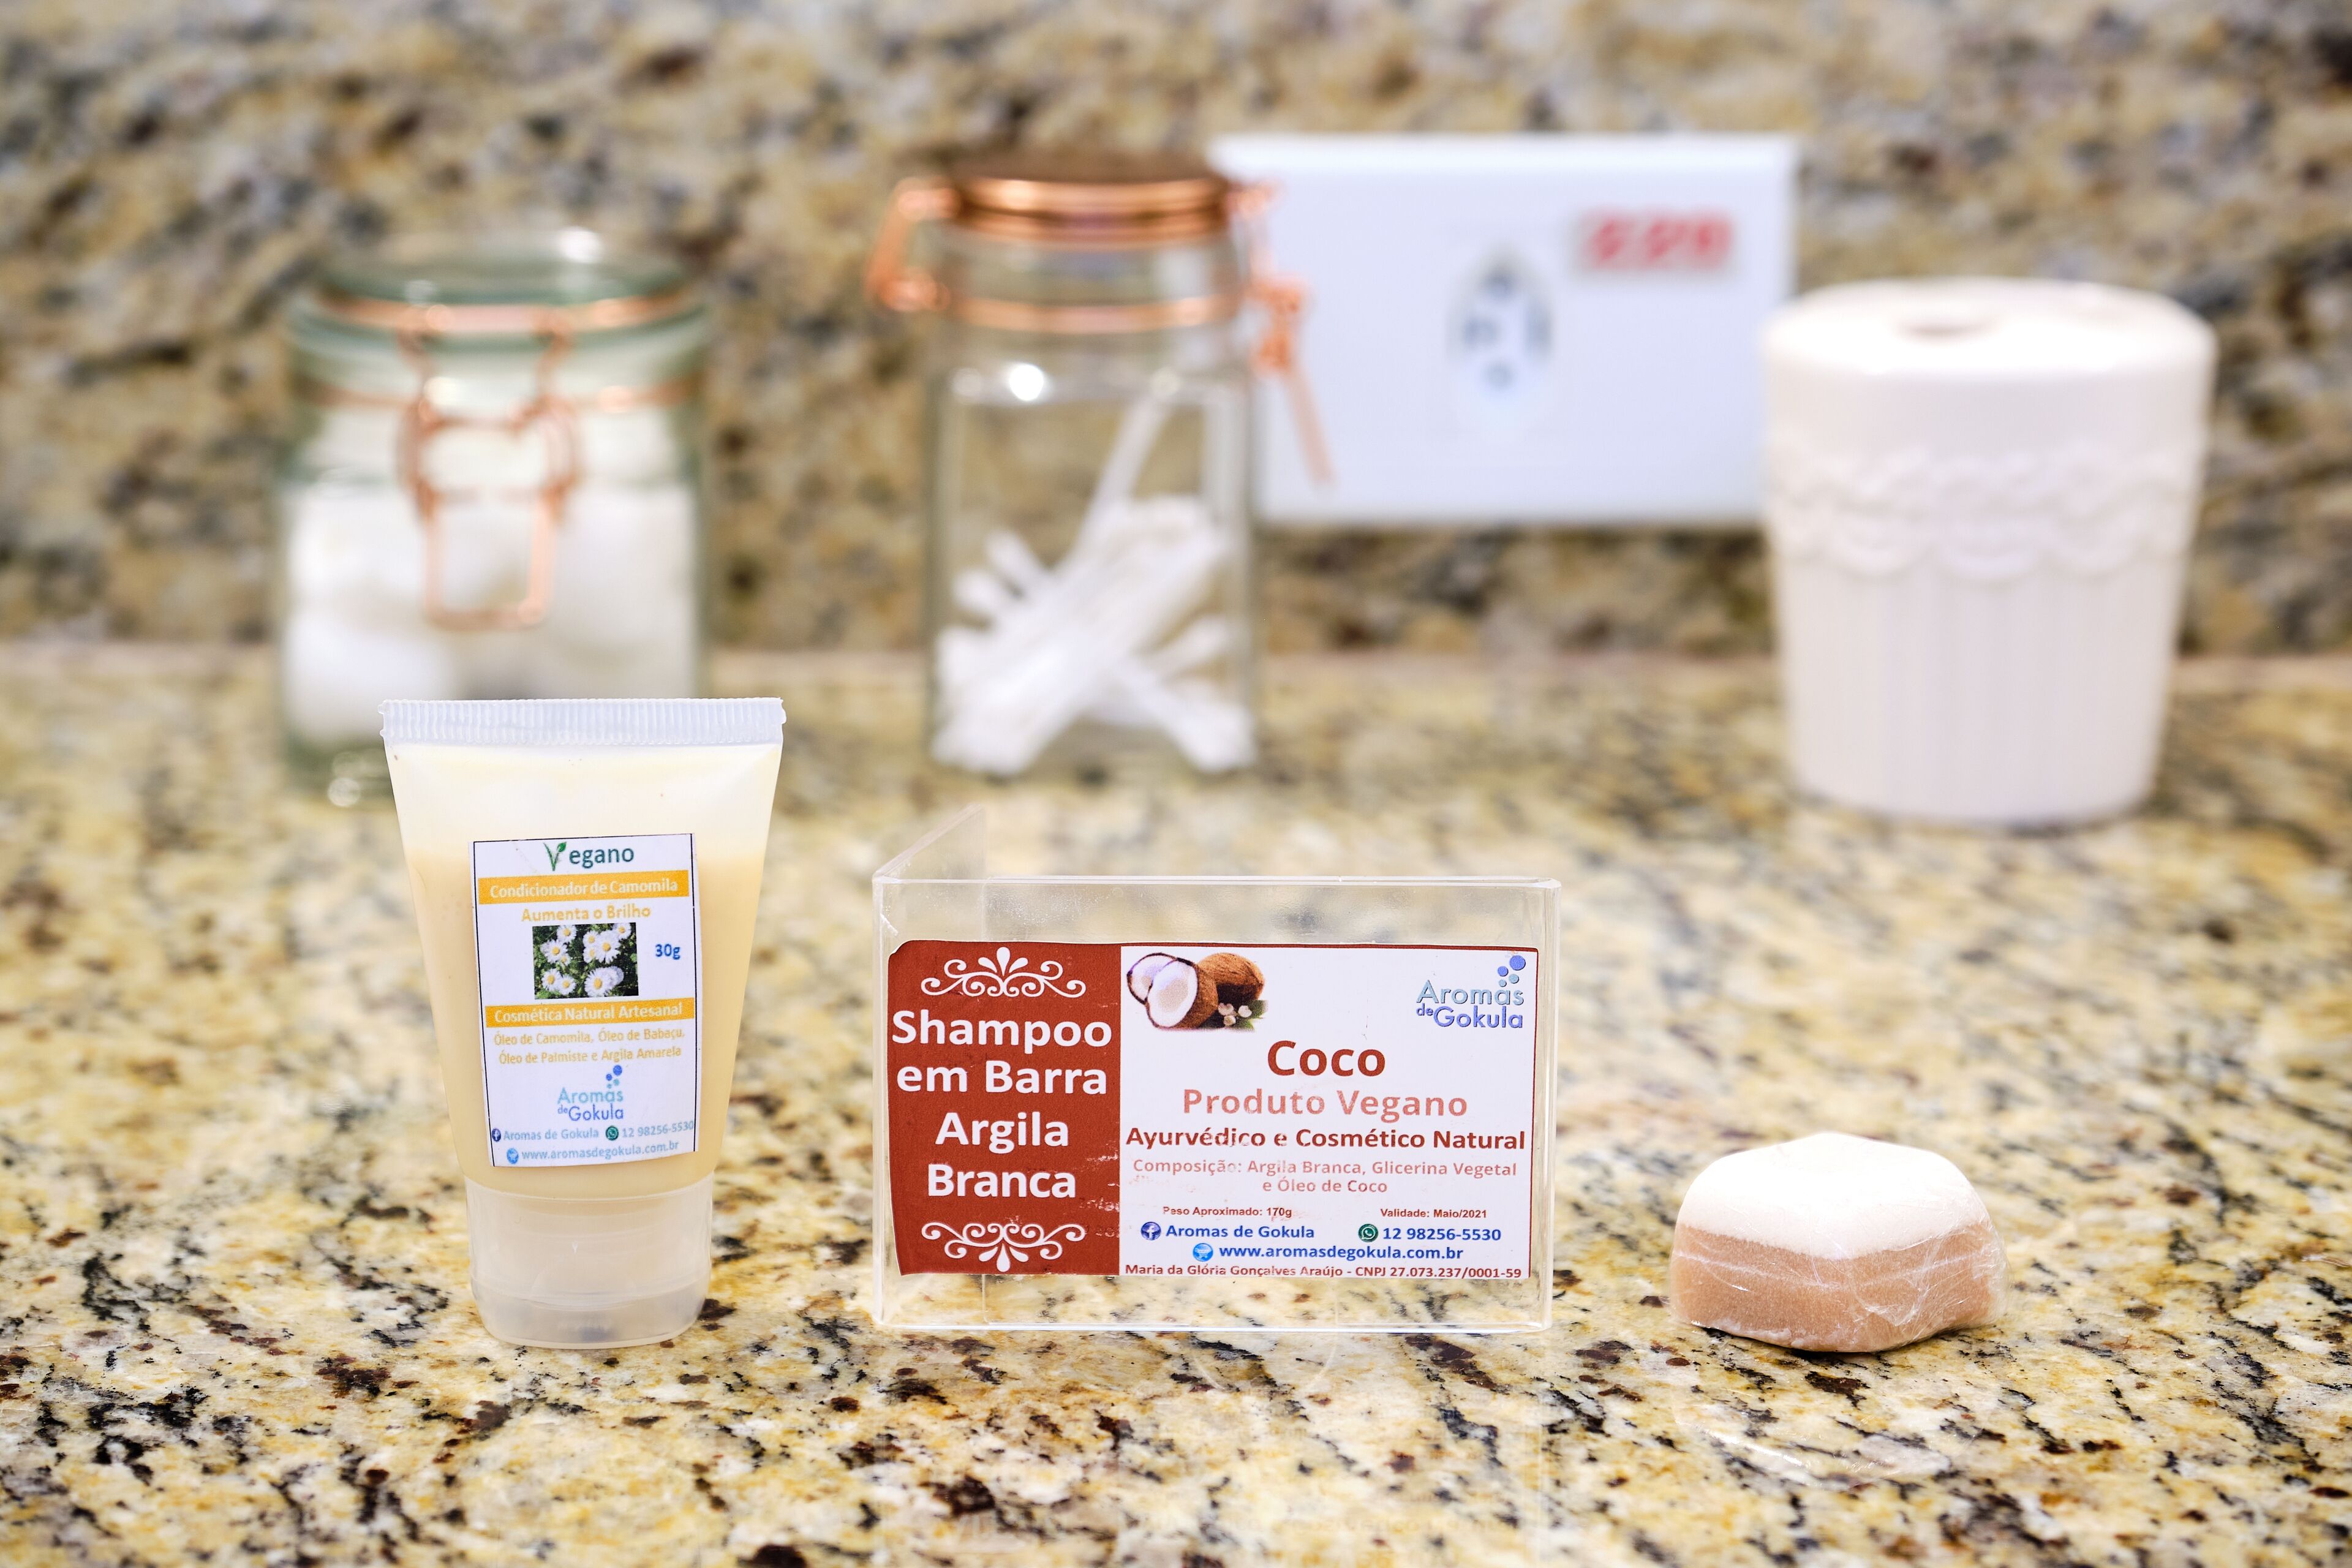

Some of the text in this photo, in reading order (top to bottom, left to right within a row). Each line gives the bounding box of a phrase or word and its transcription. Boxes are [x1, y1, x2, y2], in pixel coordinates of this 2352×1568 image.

[543, 841, 635, 872] Vegano
[490, 877, 679, 899] Condicionador de Camomila
[521, 903, 652, 922] Aumenta o Brilho
[655, 943, 682, 960] 30g
[1416, 980, 1525, 1006] Aromas
[494, 1001, 683, 1023] Cosmética Natural Artesanal
[1416, 1003, 1523, 1029] de Gokula
[493, 1027, 685, 1046] Óleo de Camomila, Óleo de Babaçu,
[892, 1009, 1112, 1054] Shampoo
[499, 1046, 682, 1065] Óleo de Palmiste e Argila Amarela
[1267, 1039, 1386, 1077] Coco
[897, 1060, 1107, 1095] em Barra
[557, 1087, 624, 1104] Aromas
[557, 1103, 624, 1121] de Gokula
[1183, 1088, 1468, 1123] Produto Vegano
[503, 1128, 599, 1140] Aromas de Gokula
[622, 1120, 694, 1138] 12 98256-5530
[935, 1111, 1069, 1154] Argila
[1126, 1126, 1525, 1150] Ayurvédico e Cosmético Natural
[521, 1140, 679, 1159] www.aromasdegokula.com.br
[1133, 1159, 1517, 1179] Composição: Argila Branca, Glicerina Vegetal
[927, 1164, 1076, 1198] Branca
[1263, 1176, 1388, 1193] e Óleo de Coco
[1163, 1207, 1292, 1218] Peso Aproximado: 170g
[1380, 1208, 1487, 1218] Validade: Maio/2021
[1166, 1225, 1315, 1238] Aromas de Gokula
[1382, 1227, 1501, 1241] 12 98256-5530
[1218, 1245, 1463, 1261] www.aromasdegokula.com.br
[1125, 1265, 1163, 1275] Maria
[1167, 1264, 1183, 1275] da
[1187, 1264, 1226, 1276] Glória
[1230, 1265, 1296, 1277] Gonçalves
[1300, 1265, 1343, 1278] Araújo
[1355, 1267, 1386, 1277] CNPJ
[1390, 1267, 1521, 1280] 27.073.237/0001-59
